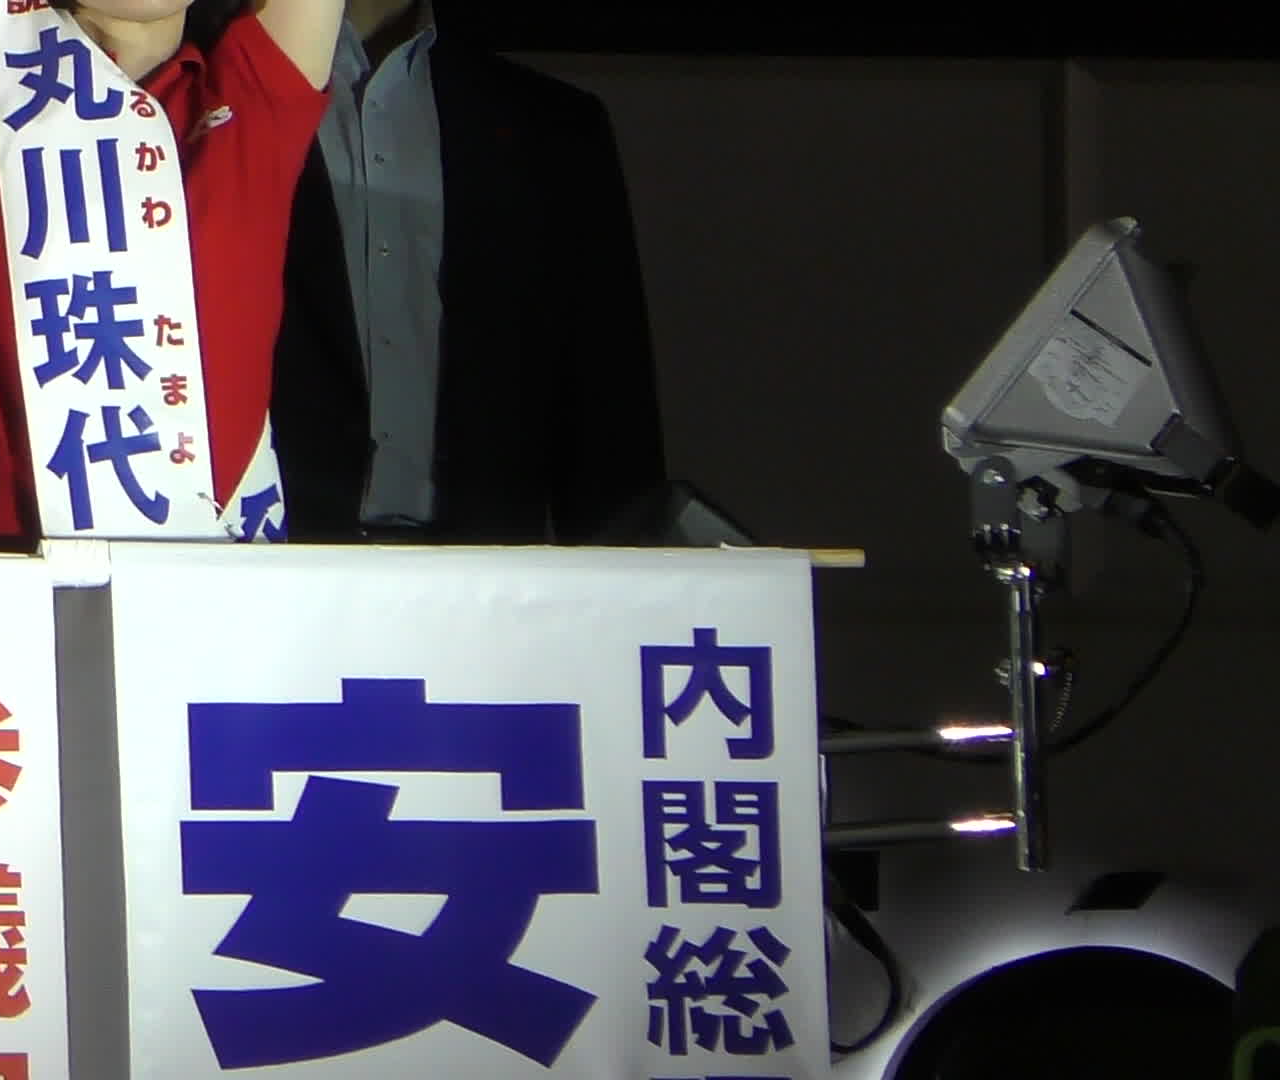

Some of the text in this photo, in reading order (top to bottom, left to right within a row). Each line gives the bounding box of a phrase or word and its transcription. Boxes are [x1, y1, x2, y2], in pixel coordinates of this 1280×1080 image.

[2, 26, 172, 531] 丸川珠代
[179, 677, 600, 1070] 安
[639, 627, 796, 1080] 内閣総
